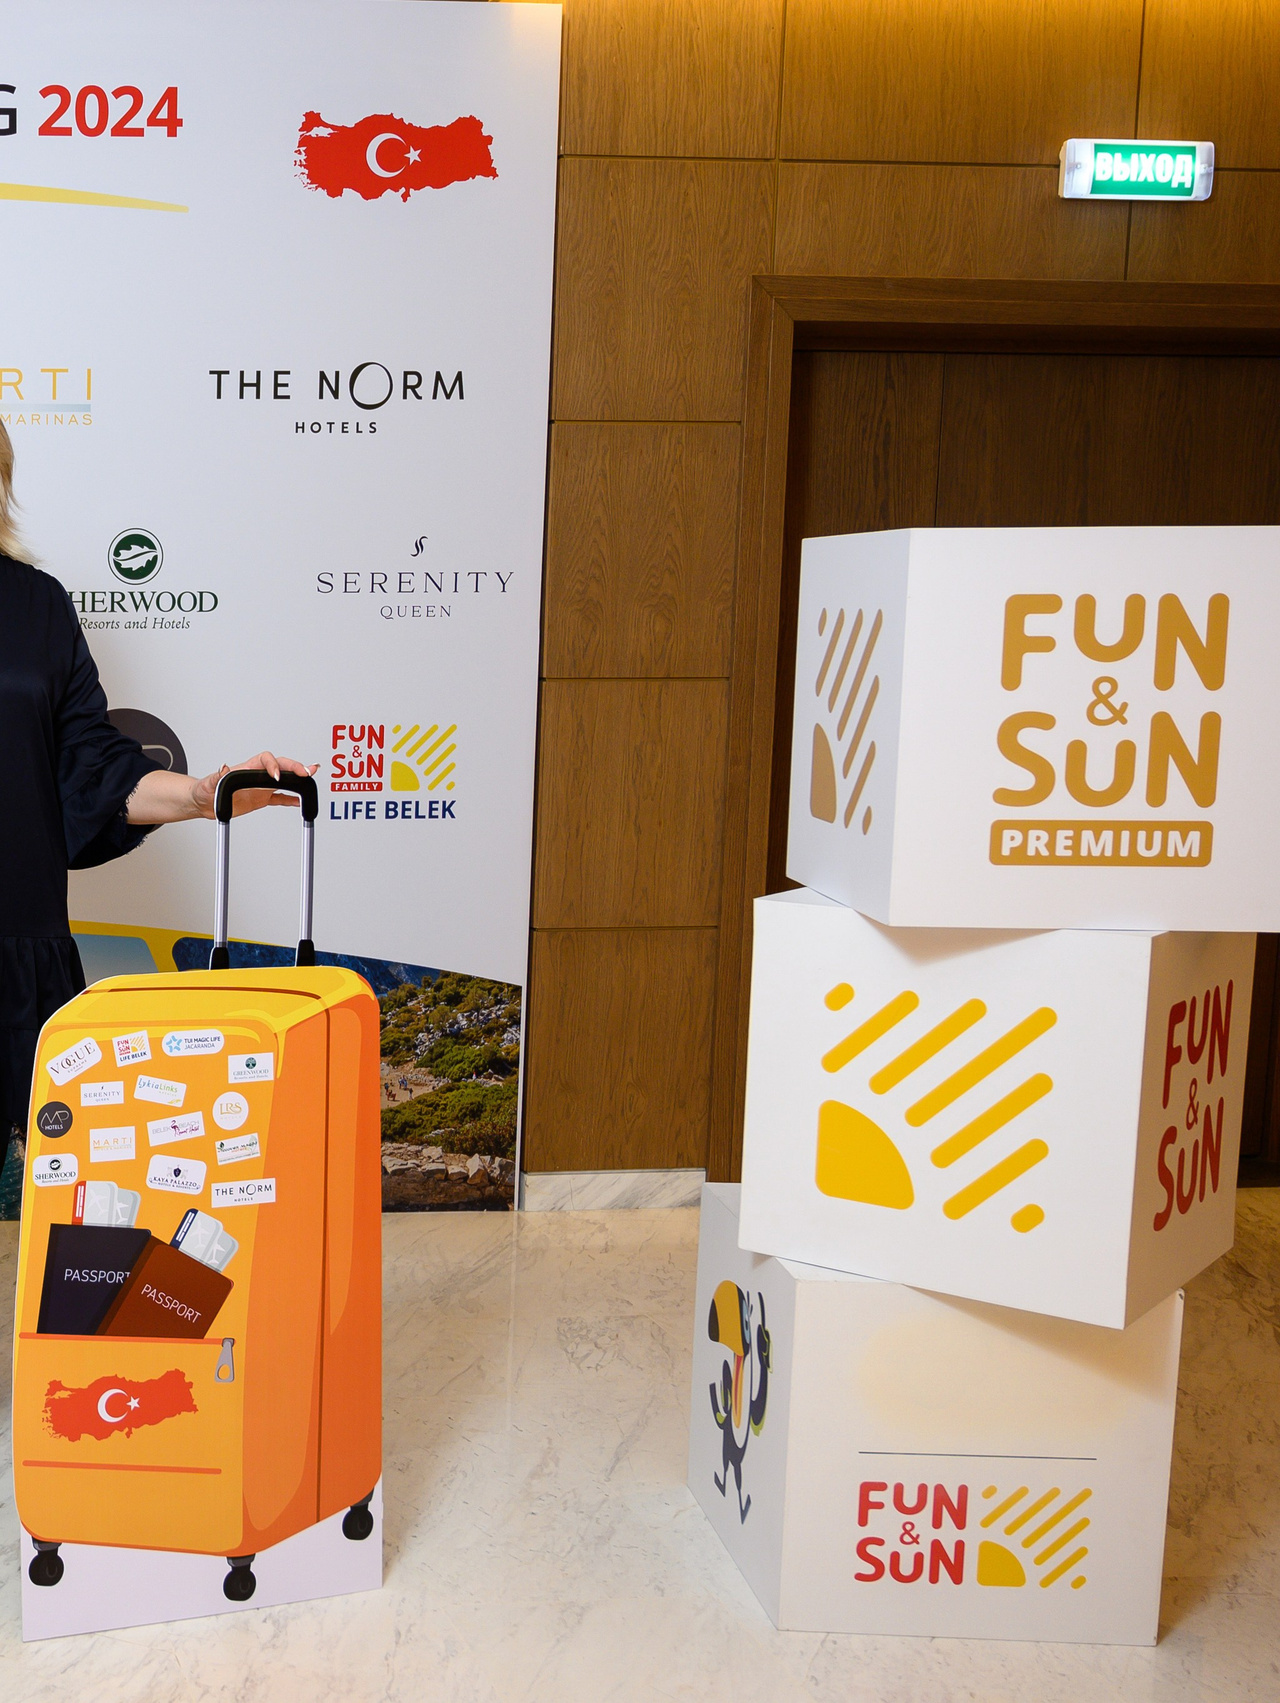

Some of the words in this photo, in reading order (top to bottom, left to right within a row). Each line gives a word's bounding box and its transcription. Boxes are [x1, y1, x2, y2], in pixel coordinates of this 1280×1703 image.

[37, 84, 184, 138] 2024
[1095, 152, 1193, 188] ВЫХОД
[209, 370, 291, 400] THE
[318, 361, 464, 410] NORM
[295, 421, 377, 433] HOTELS
[316, 571, 514, 594] SERENITY
[68, 591, 219, 613] HERWOOD
[380, 605, 452, 620] QUEEN
[79, 617, 120, 630] Resorts
[124, 617, 147, 630] and
[152, 617, 191, 630] Hotels
[1000, 592, 1230, 692] FUN
[1086, 675, 1129, 726] &
[332, 724, 385, 749] FUN
[352, 745, 363, 758] &
[992, 710, 1222, 809] SUN
[331, 753, 384, 778] SUN
[335, 783, 378, 791] FAMILY
[330, 801, 376, 820] LIFE
[384, 800, 457, 819] BELEK
[1001, 829, 1201, 858] PREMIUM
[184, 1042, 215, 1050] JACARANDA
[1162, 979, 1234, 1110] FUN
[50, 1042, 96, 1075] VOGUE
[119, 1054, 131, 1062] LIFE
[131, 1051, 147, 1059] BELEK
[83, 1090, 121, 1099] SERENITY
[1185, 1077, 1200, 1131] &
[40, 1110, 69, 1129] MP
[219, 1102, 242, 1115] LRS
[93, 1137, 132, 1146] MARTI
[35, 1171, 76, 1180] SHERWOOD
[1153, 1096, 1225, 1232] SUN
[170, 1179, 198, 1187] PALAZZO
[215, 1187, 234, 1196] THE
[239, 1184, 272, 1195] NORM
[140, 1283, 202, 1324] PASSPORT
[857, 1481, 969, 1530] FUN
[899, 1521, 921, 1545] &
[853, 1536, 966, 1586] SUN
